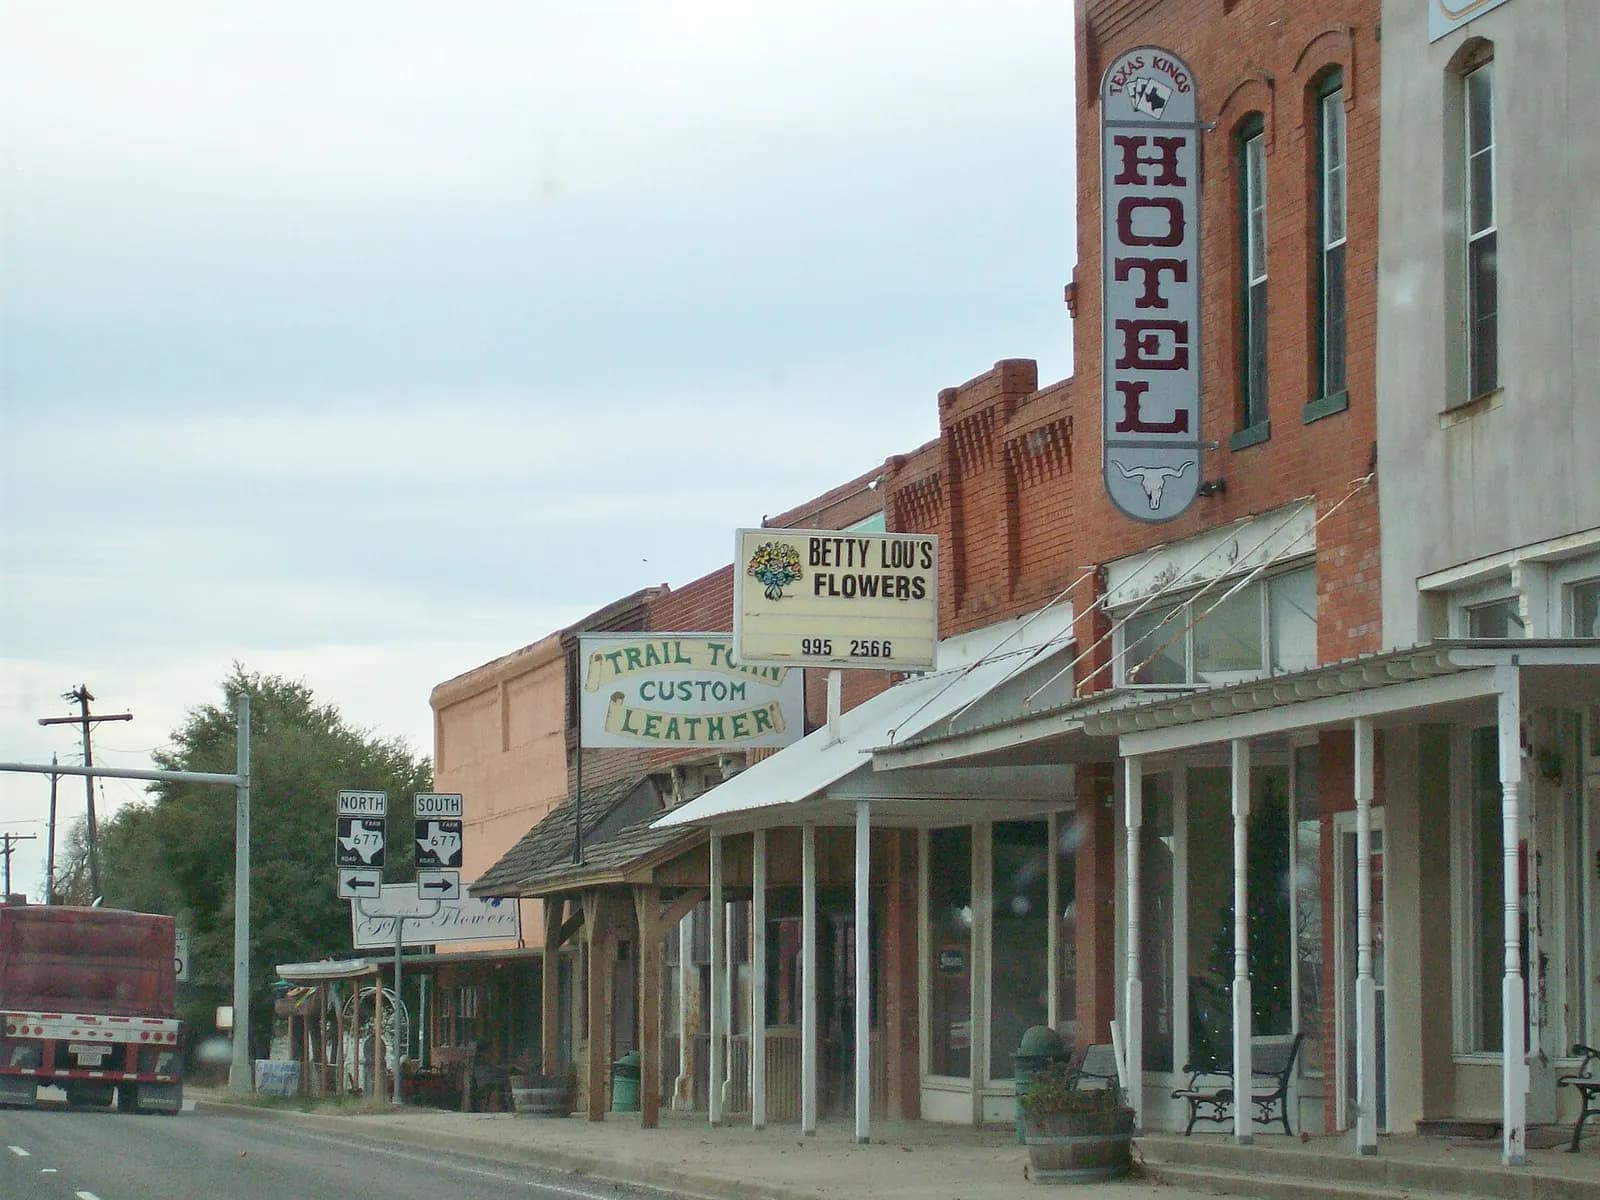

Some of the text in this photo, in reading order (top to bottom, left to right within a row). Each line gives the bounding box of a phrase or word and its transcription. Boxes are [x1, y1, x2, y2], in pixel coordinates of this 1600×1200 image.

[1109, 56, 1191, 97] TEXAS KINGS
[1113, 134, 1189, 434] HOTEL
[808, 536, 934, 570] BETTY LOU'S
[813, 572, 927, 601] FLOWERS
[801, 637, 893, 658] 995 2566
[604, 640, 781, 681] TRAIL TO
[639, 680, 747, 702] CUSTOM
[621, 709, 774, 742] LEATHER
[340, 796, 384, 811] NORTH
[418, 798, 460, 812] SOUTH
[353, 834, 379, 846] 677
[431, 835, 457, 847] 677
[439, 905, 515, 927] Flowers
